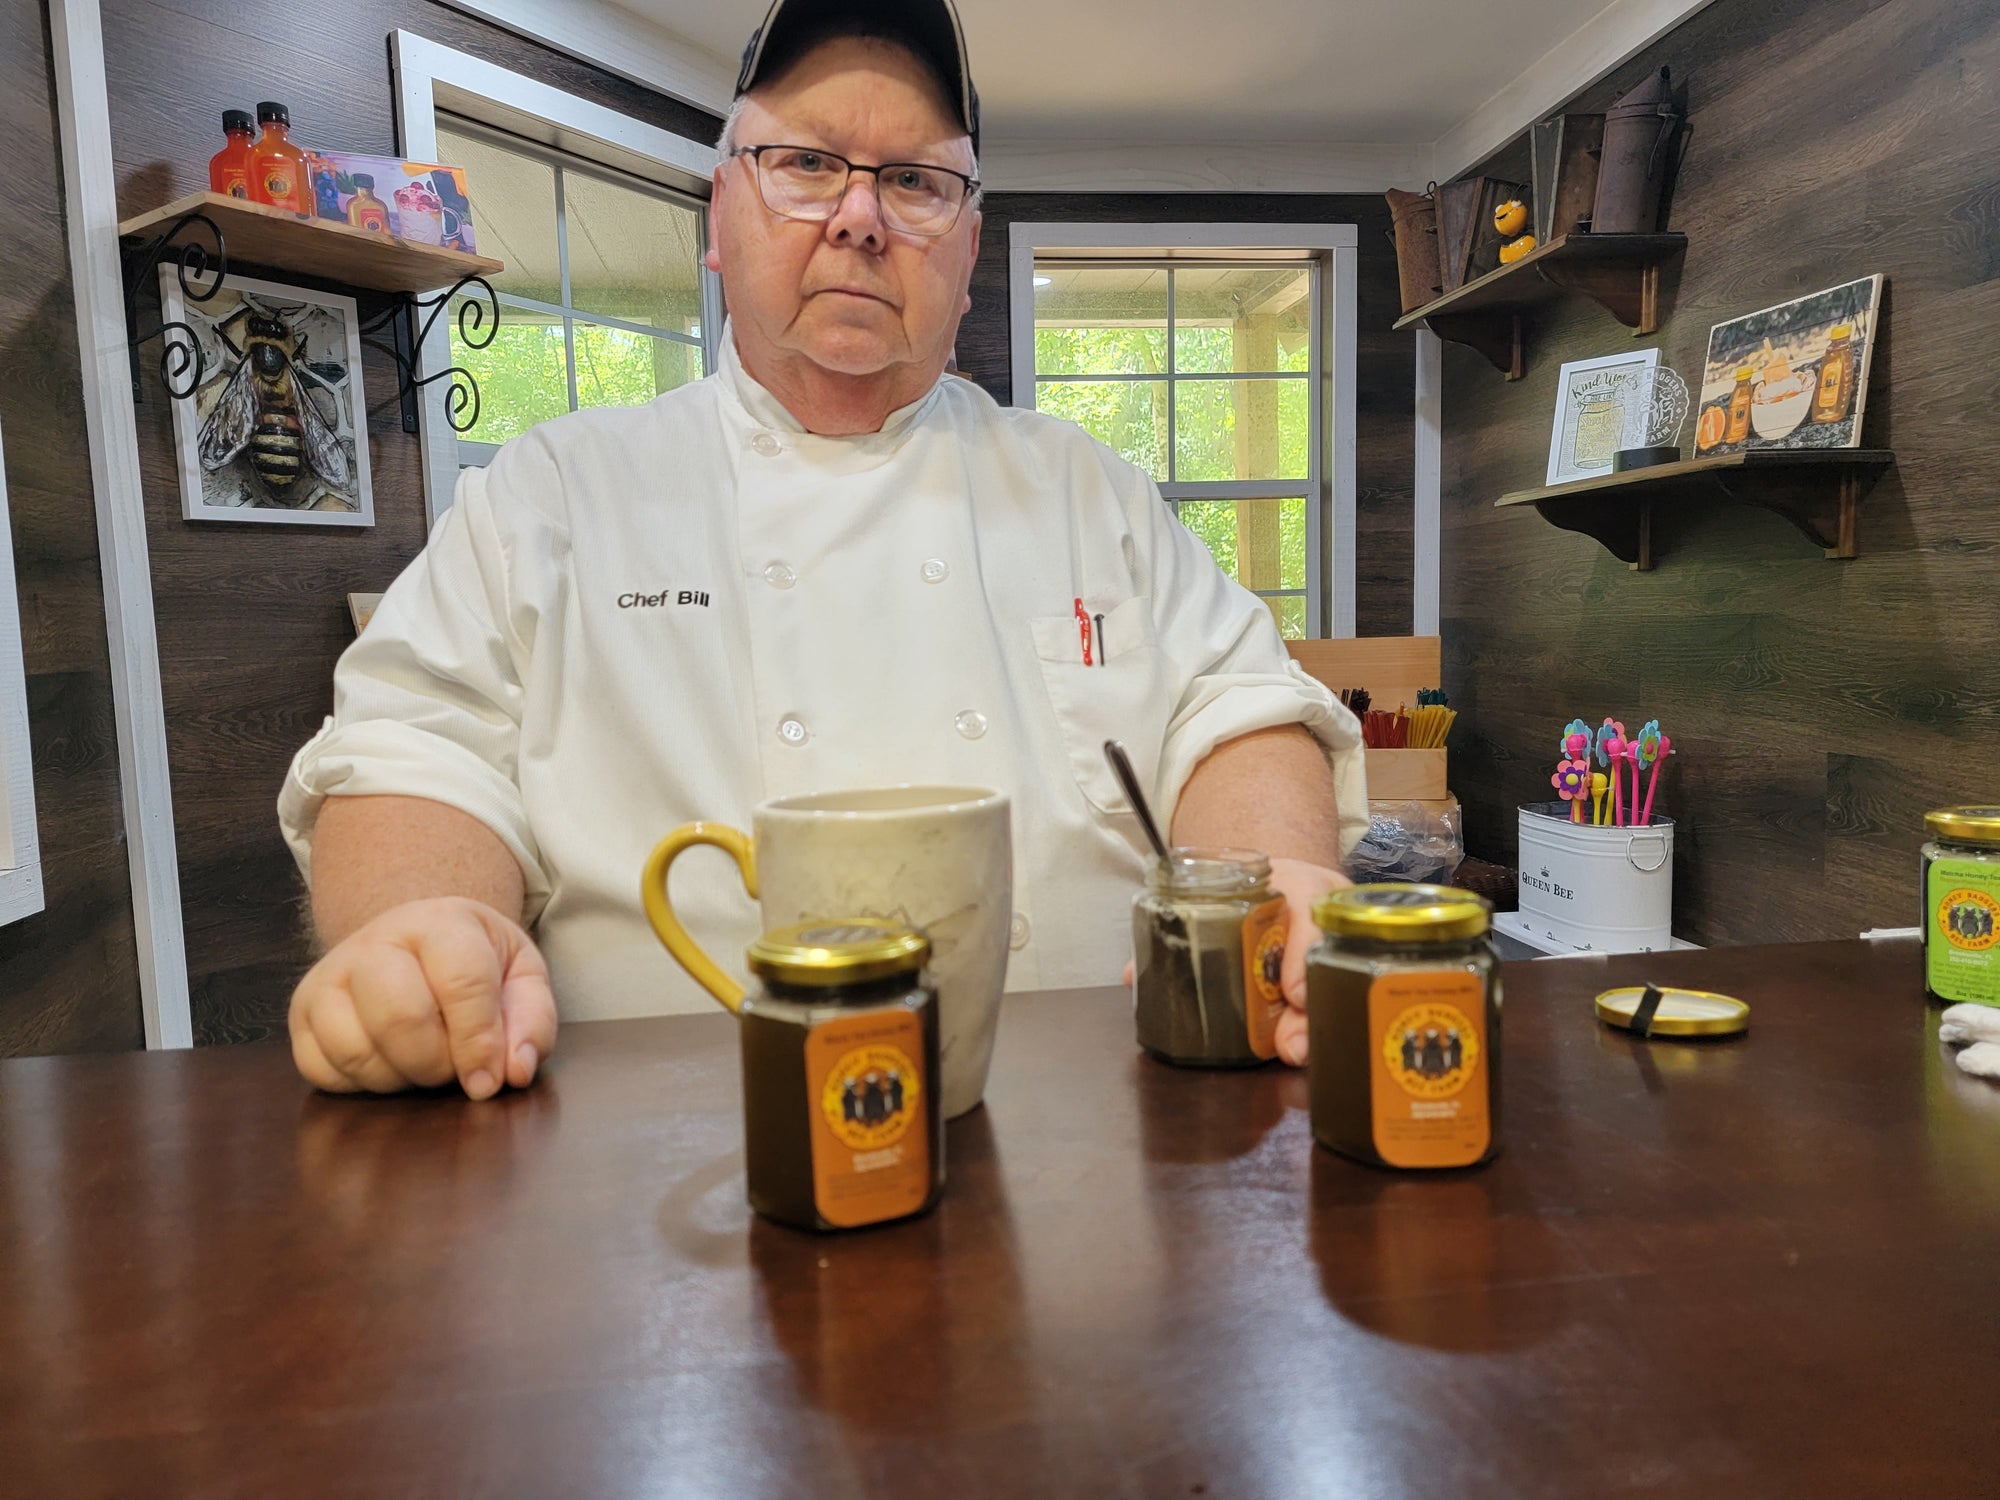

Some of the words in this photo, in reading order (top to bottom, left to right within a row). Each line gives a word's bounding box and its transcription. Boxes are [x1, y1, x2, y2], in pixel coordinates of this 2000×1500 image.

[1571, 374, 1600, 399] Kind
[617, 590, 669, 609] Chef
[677, 590, 710, 608] Bill
[1522, 871, 1550, 893] QUEEN
[1553, 883, 1574, 900] BEE
